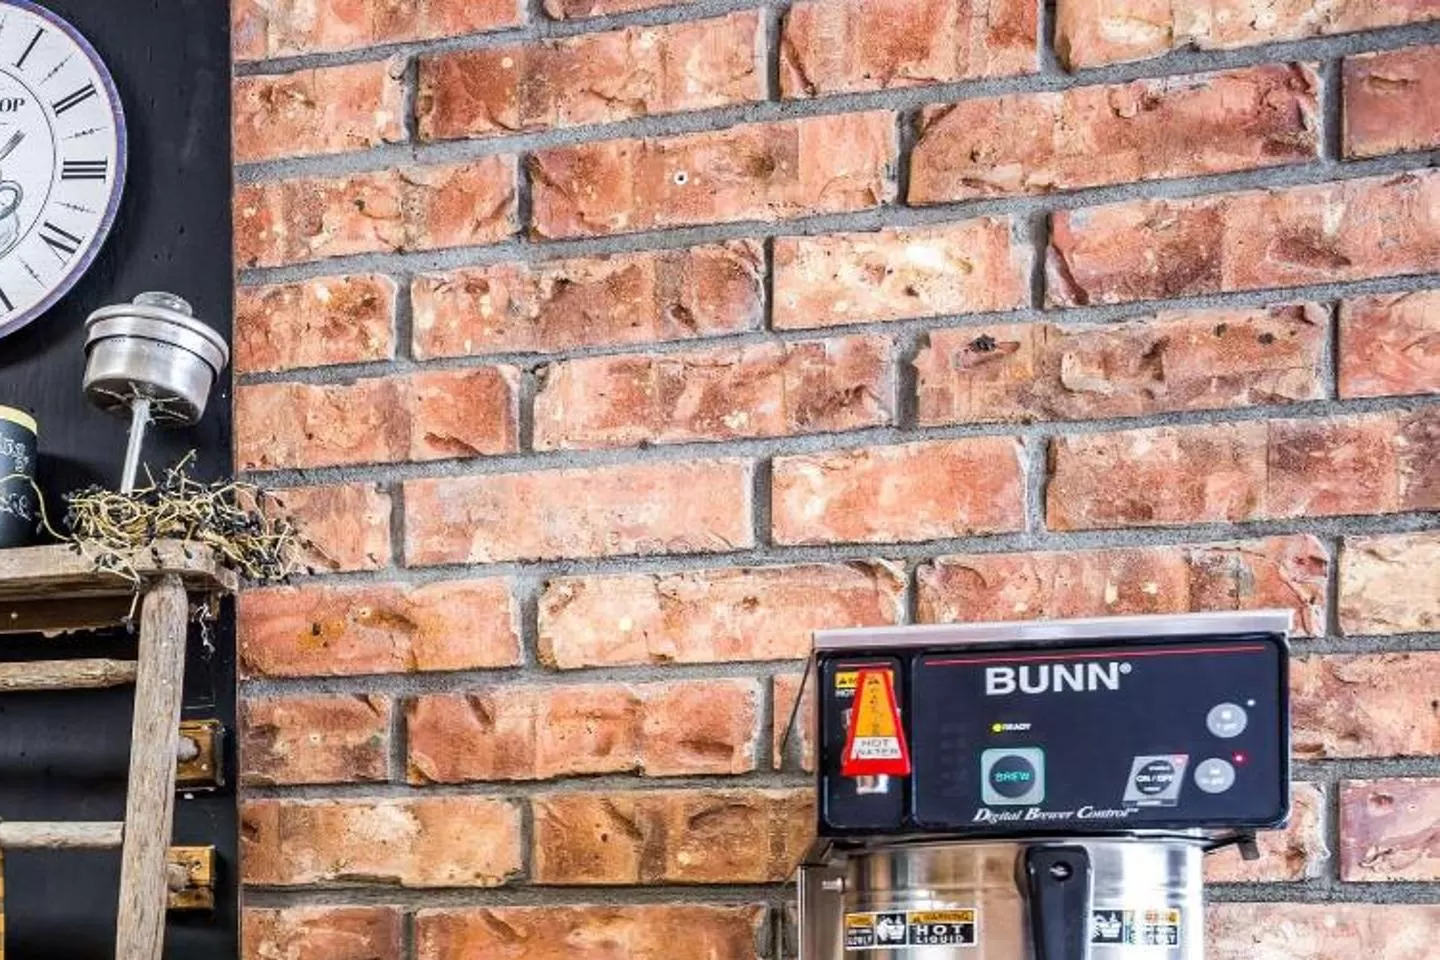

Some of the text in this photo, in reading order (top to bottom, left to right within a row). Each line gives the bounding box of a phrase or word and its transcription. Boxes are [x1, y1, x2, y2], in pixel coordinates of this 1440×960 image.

[995, 771, 1030, 782] BREW
[972, 808, 1021, 824] Digital
[1024, 807, 1073, 821] Brewer
[915, 923, 964, 936] HOT
[915, 934, 964, 944] LIQUID
